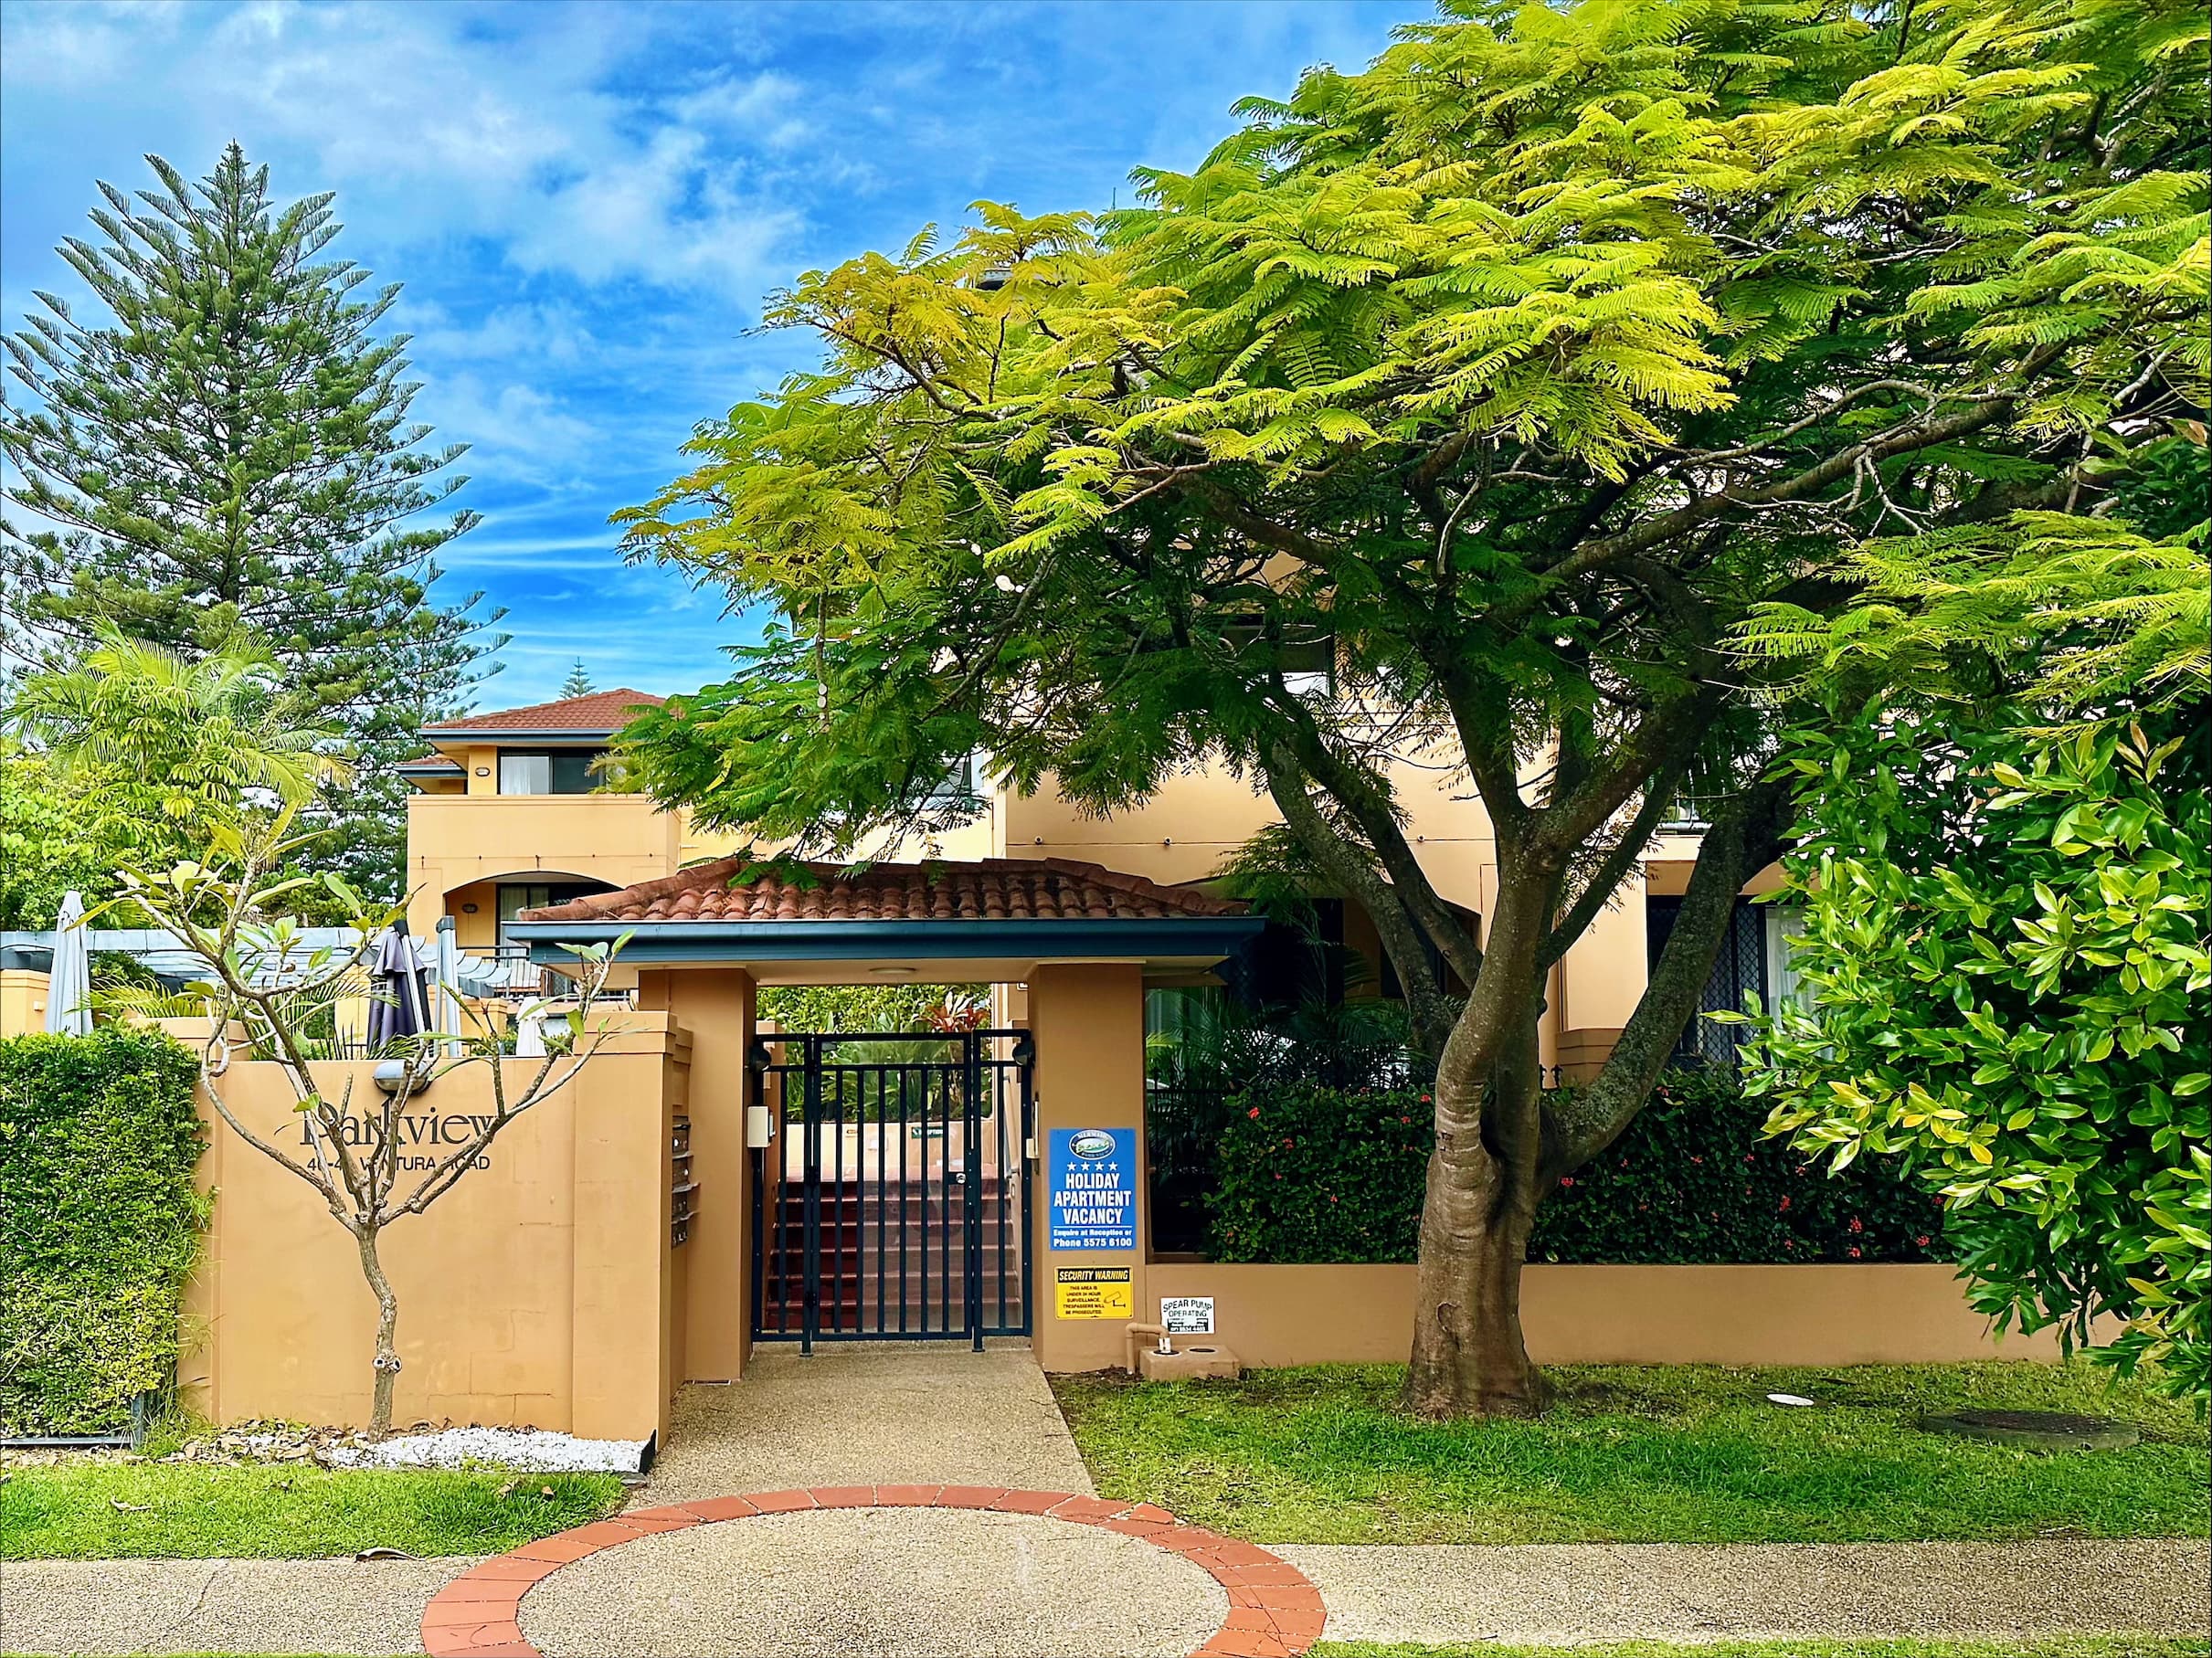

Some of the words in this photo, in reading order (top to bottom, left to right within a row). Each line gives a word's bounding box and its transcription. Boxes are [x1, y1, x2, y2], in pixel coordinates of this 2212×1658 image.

[1065, 1172, 1120, 1189] HOLIDAY
[1053, 1190, 1132, 1207] APARTMENT
[1063, 1208, 1123, 1225] VACANCY
[1089, 1229, 1124, 1237] Reception
[1053, 1238, 1082, 1247] Phone
[1084, 1238, 1106, 1247] 5575
[1108, 1238, 1132, 1247] 6100
[1059, 1270, 1095, 1281] SECURITY
[1095, 1270, 1129, 1281] WARNING
[1163, 1299, 1189, 1313] SPEAR
[1191, 1299, 1212, 1311] PUMP
[1169, 1309, 1207, 1317] OPERATING
